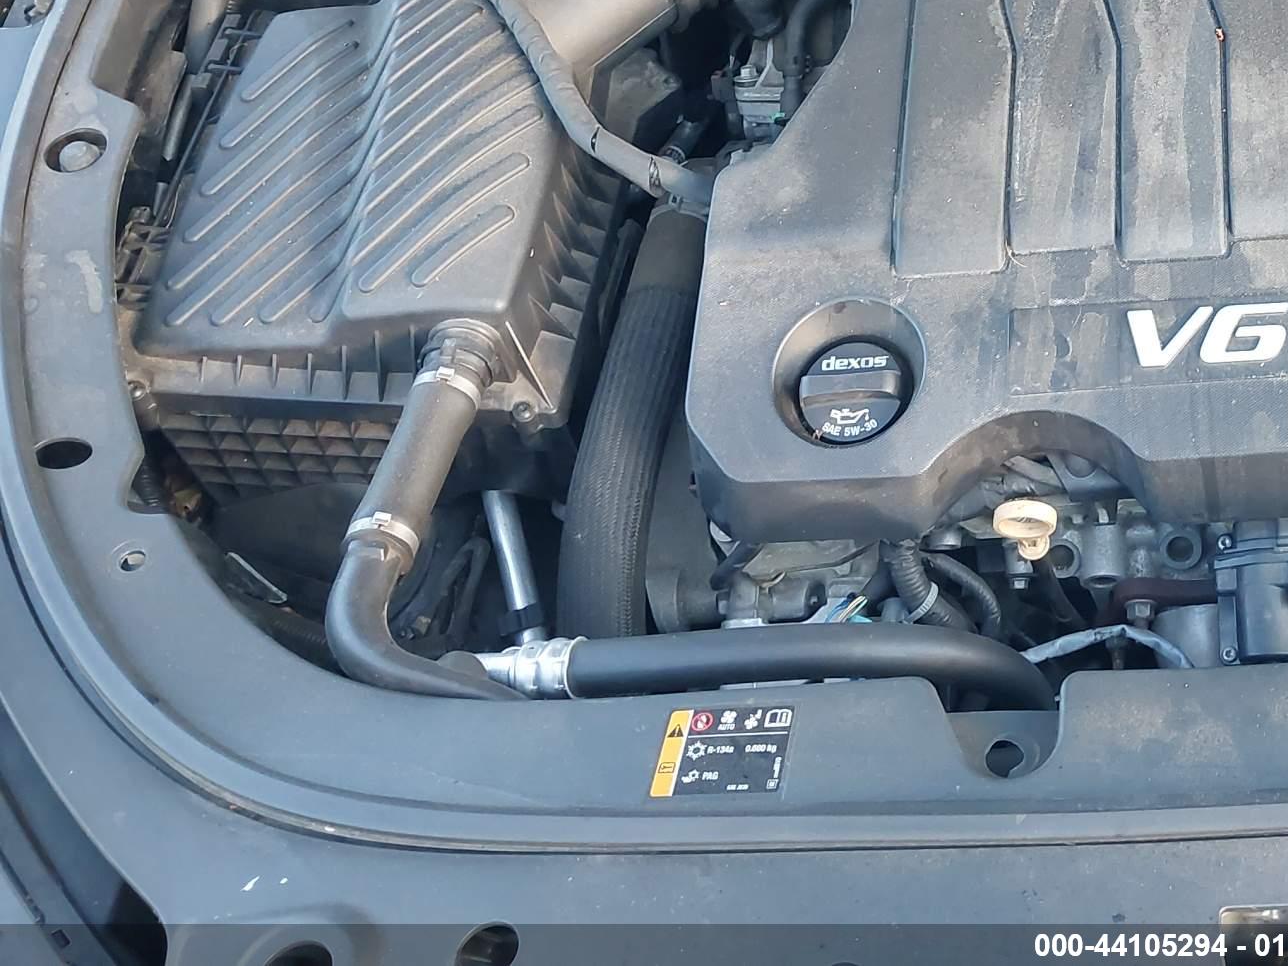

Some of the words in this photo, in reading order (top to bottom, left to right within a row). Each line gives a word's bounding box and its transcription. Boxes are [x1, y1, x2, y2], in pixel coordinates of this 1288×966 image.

[821, 355, 889, 371] dexos
[822, 422, 842, 436] SAE
[844, 419, 878, 437] 5W-30
[702, 772, 718, 780] PAG
